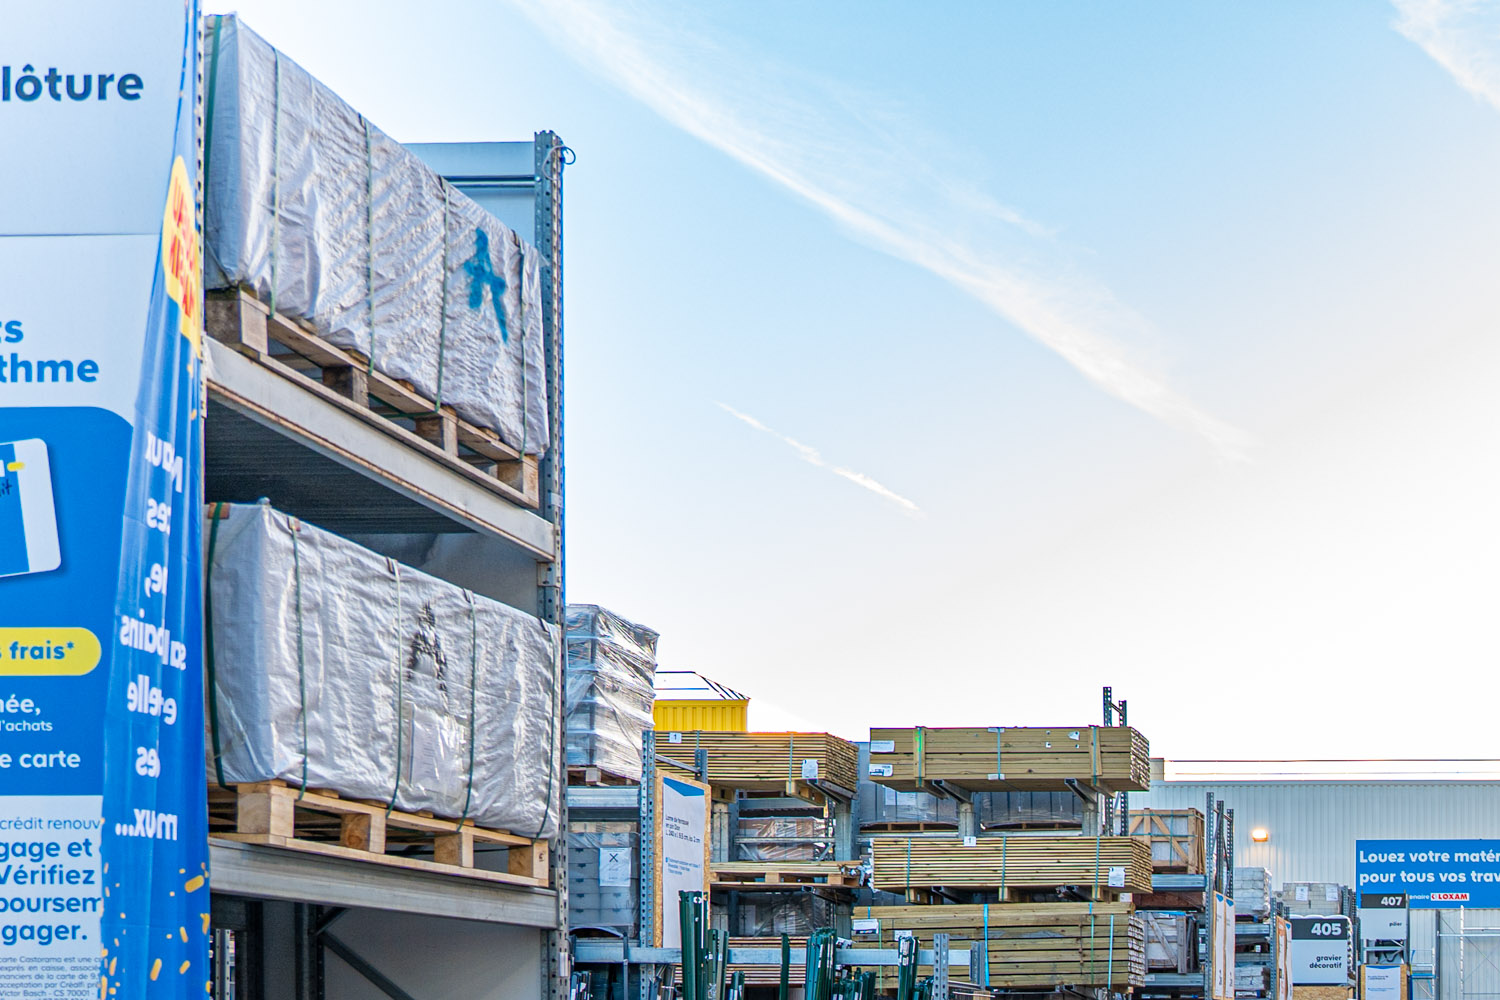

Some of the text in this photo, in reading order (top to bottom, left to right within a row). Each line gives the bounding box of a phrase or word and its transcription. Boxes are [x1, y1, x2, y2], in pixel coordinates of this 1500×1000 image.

[19, 751, 81, 768] carte
[0, 817, 43, 830] crédit
[67, 838, 93, 858] et
[1359, 850, 1405, 863] Louez
[1409, 850, 1451, 863] votre
[1359, 873, 1397, 887] pour
[1400, 870, 1435, 883] tous
[1439, 872, 1467, 883] vos
[1381, 896, 1403, 906] 407
[1408, 892, 1430, 901] enaire
[1, 925, 88, 946] gager.
[1311, 922, 1342, 936] 405
[1309, 961, 1342, 969] décoratif
[1316, 954, 1342, 963] gravier
[23, 989, 47, 997] Basch
